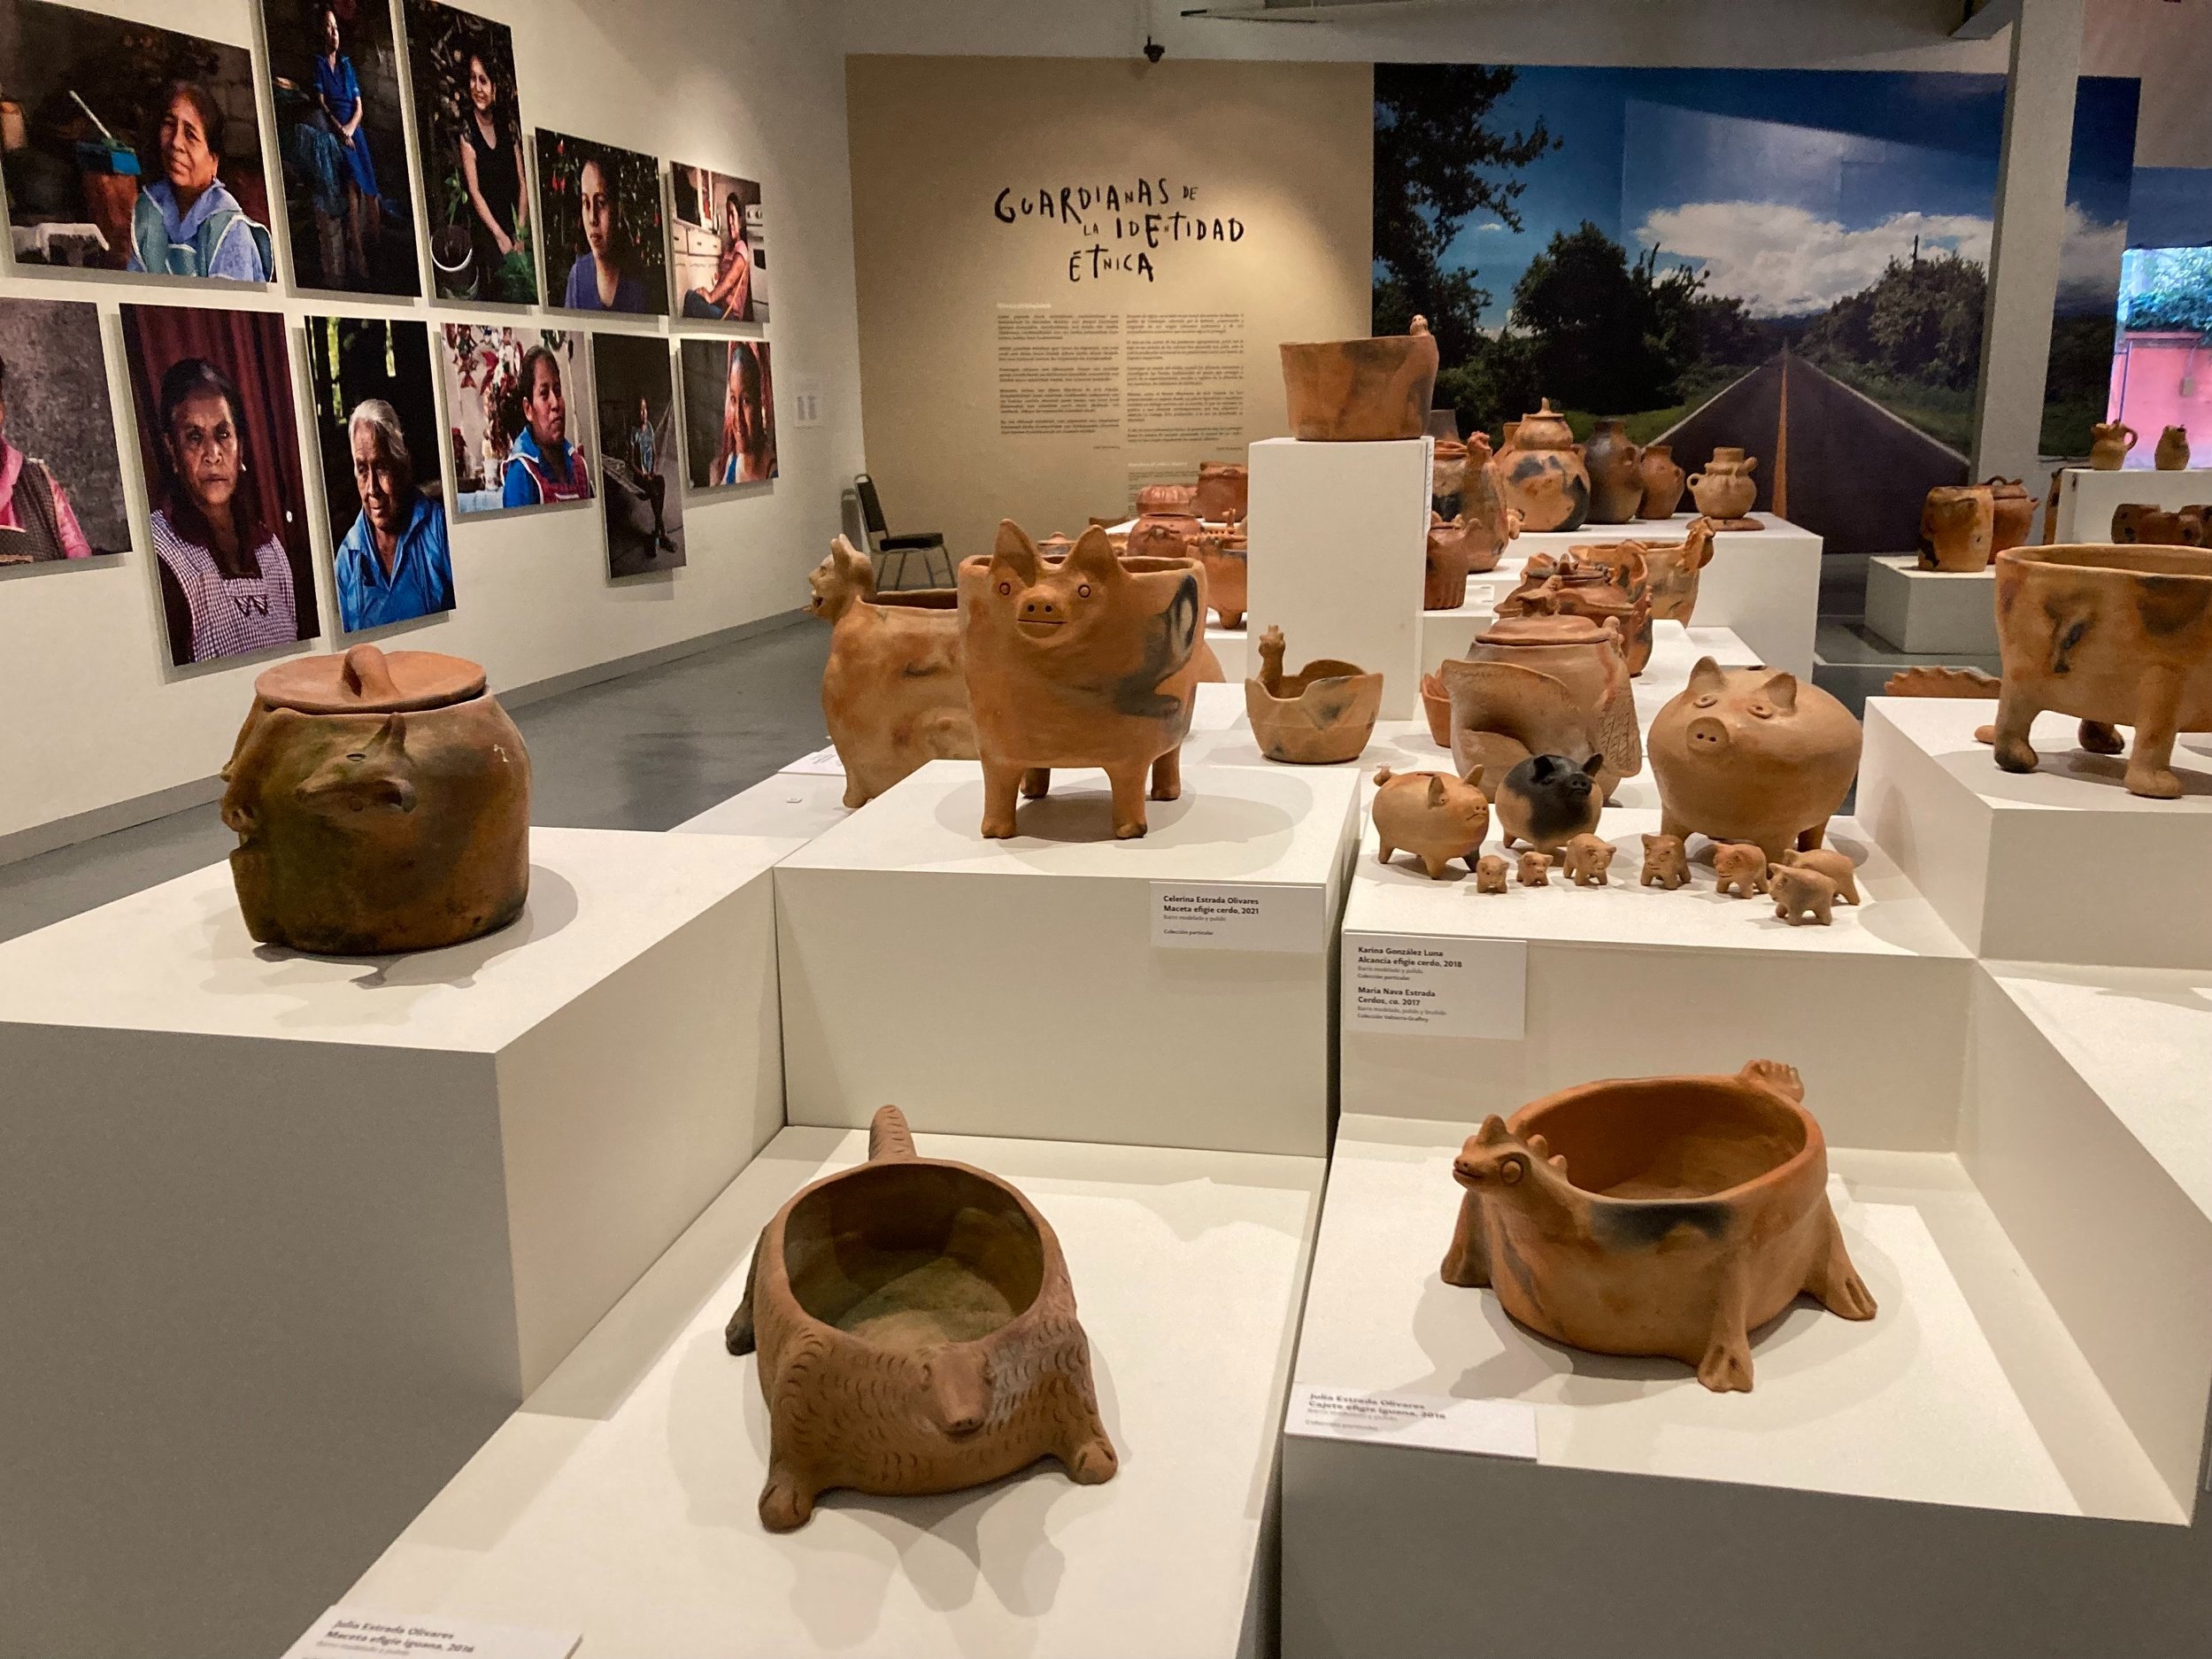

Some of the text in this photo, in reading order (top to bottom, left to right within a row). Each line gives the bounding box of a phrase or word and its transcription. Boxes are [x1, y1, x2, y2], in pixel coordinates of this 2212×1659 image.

[994, 178, 1198, 224] GUARDIANAS DE
[1083, 212, 1245, 248] LA IDENTIDAD
[1069, 244, 1153, 282] ÉTNICA
[1194, 906, 1214, 914] efigie
[1393, 958, 1415, 967] efigie
[1337, 1395, 1377, 1404] Estrada
[1381, 1400, 1425, 1408] Olivares
